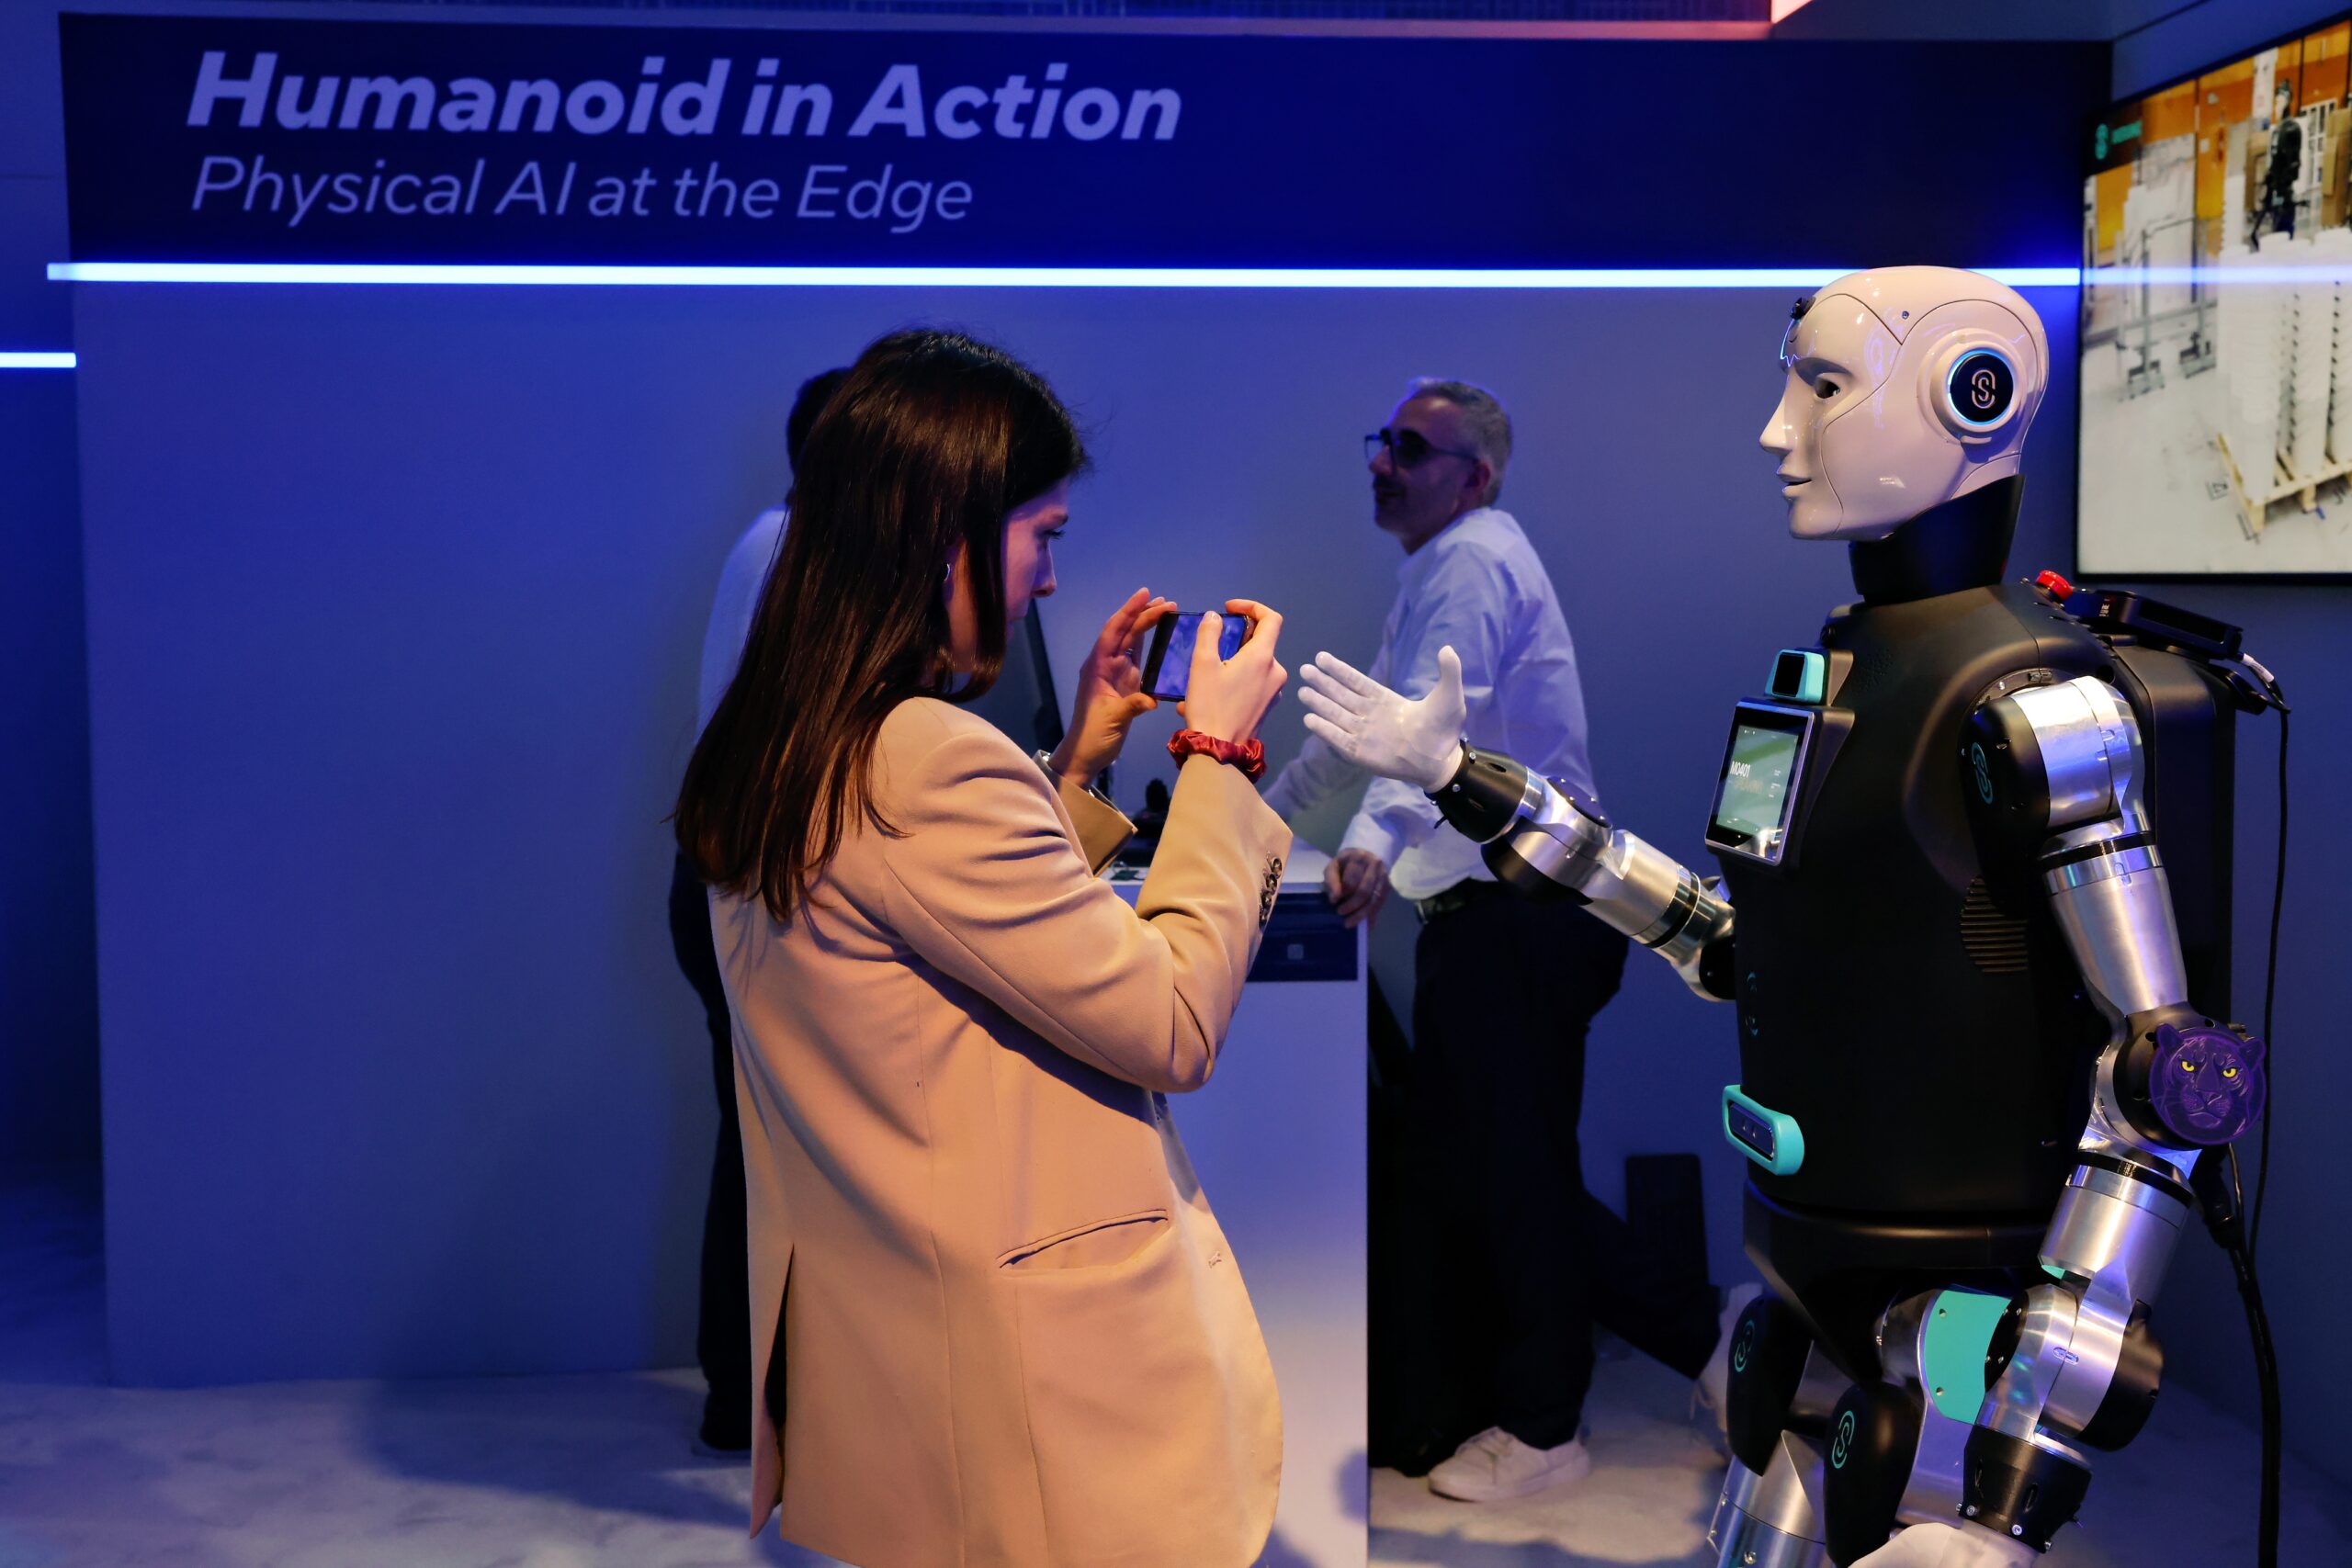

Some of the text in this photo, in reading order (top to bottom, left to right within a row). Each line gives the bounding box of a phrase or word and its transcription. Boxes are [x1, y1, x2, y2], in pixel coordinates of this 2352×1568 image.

[187, 51, 1182, 141] Humanoid in Action
[192, 155, 973, 233] Physical AI at the Edge
